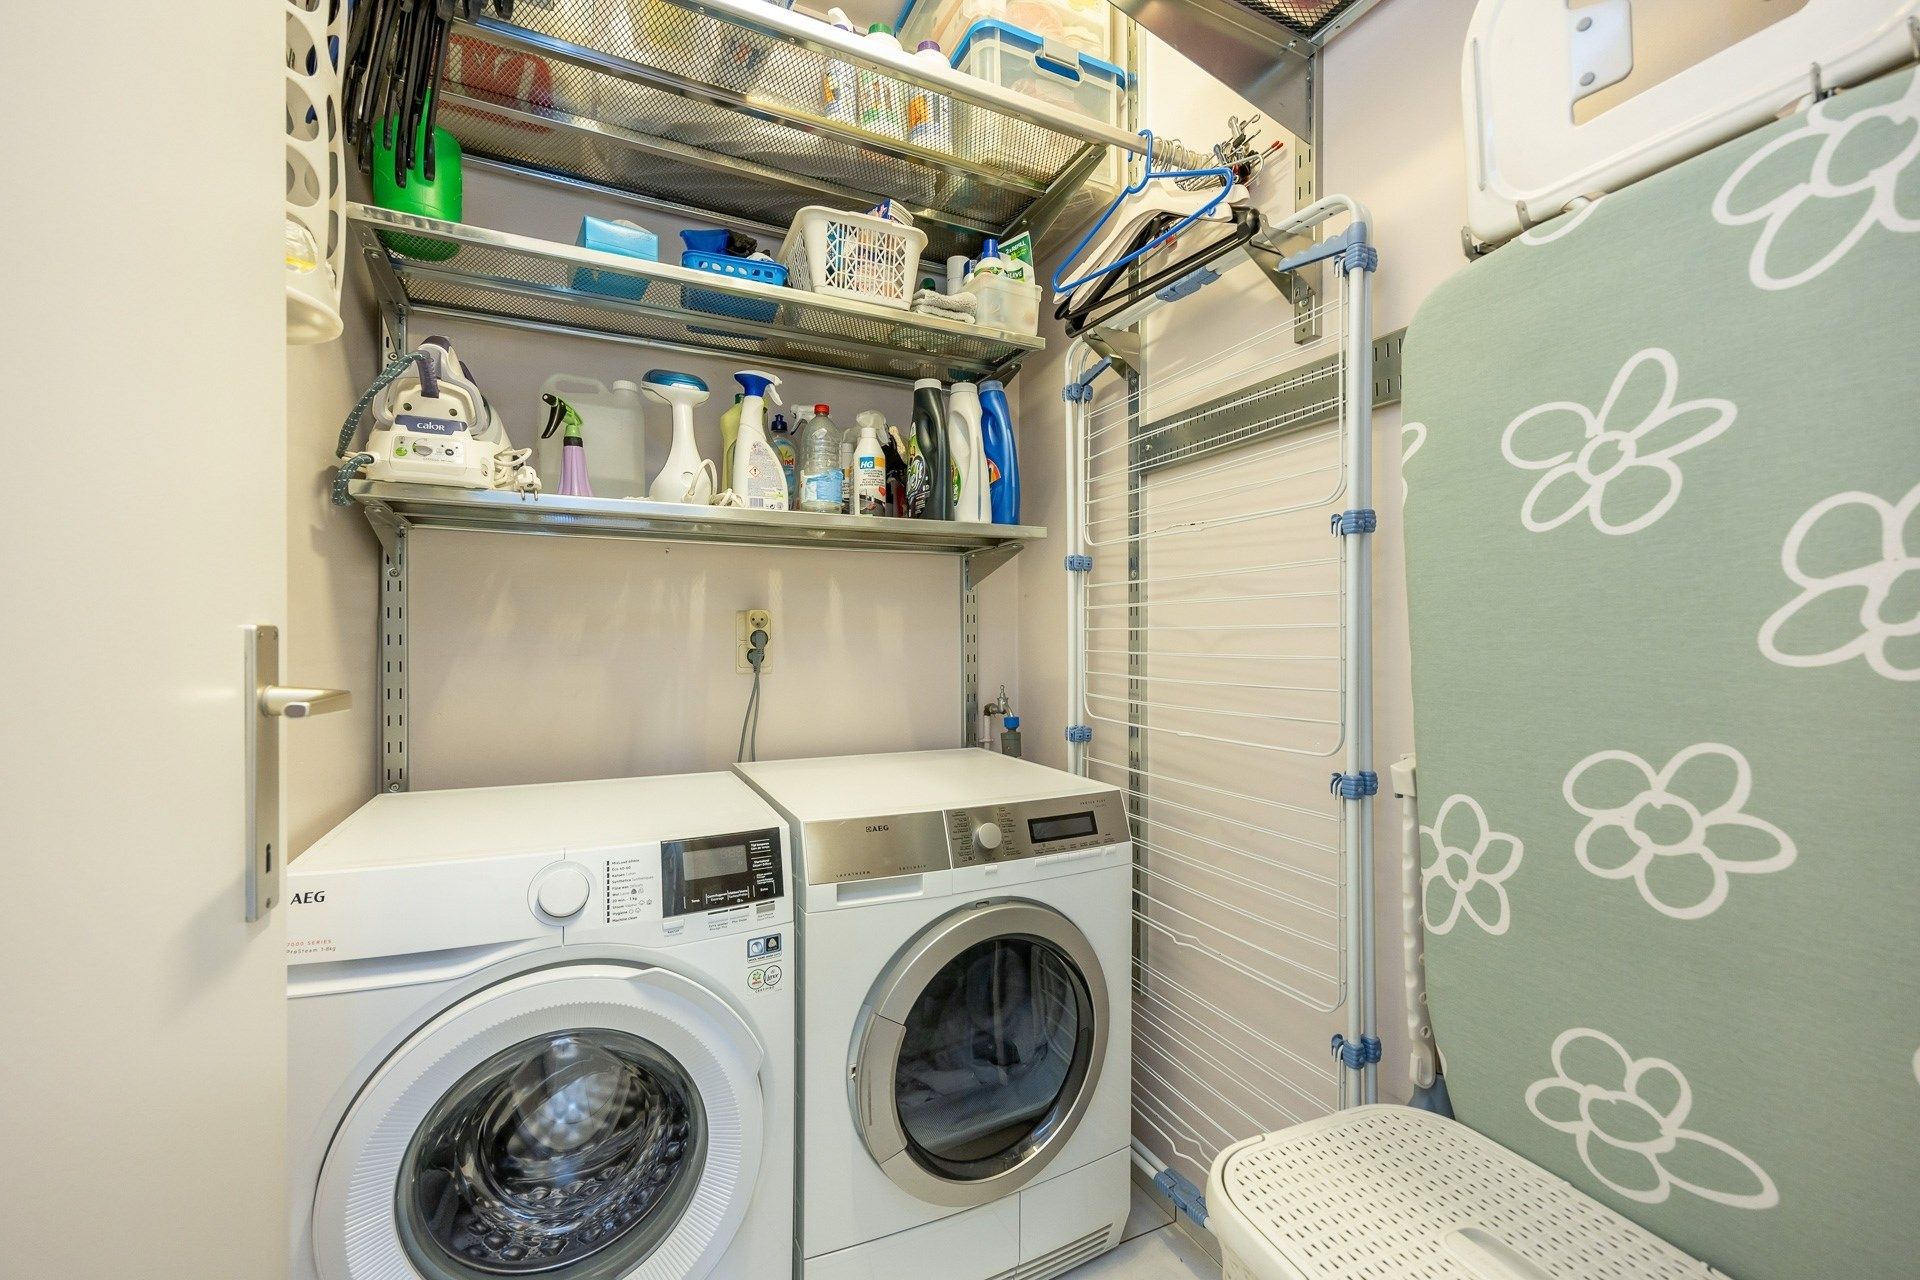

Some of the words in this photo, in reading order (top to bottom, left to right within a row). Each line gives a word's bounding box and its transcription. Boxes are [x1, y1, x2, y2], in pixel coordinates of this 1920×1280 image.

[860, 460, 874, 469] HG
[871, 825, 889, 833] AEG
[290, 890, 326, 905] AEG
